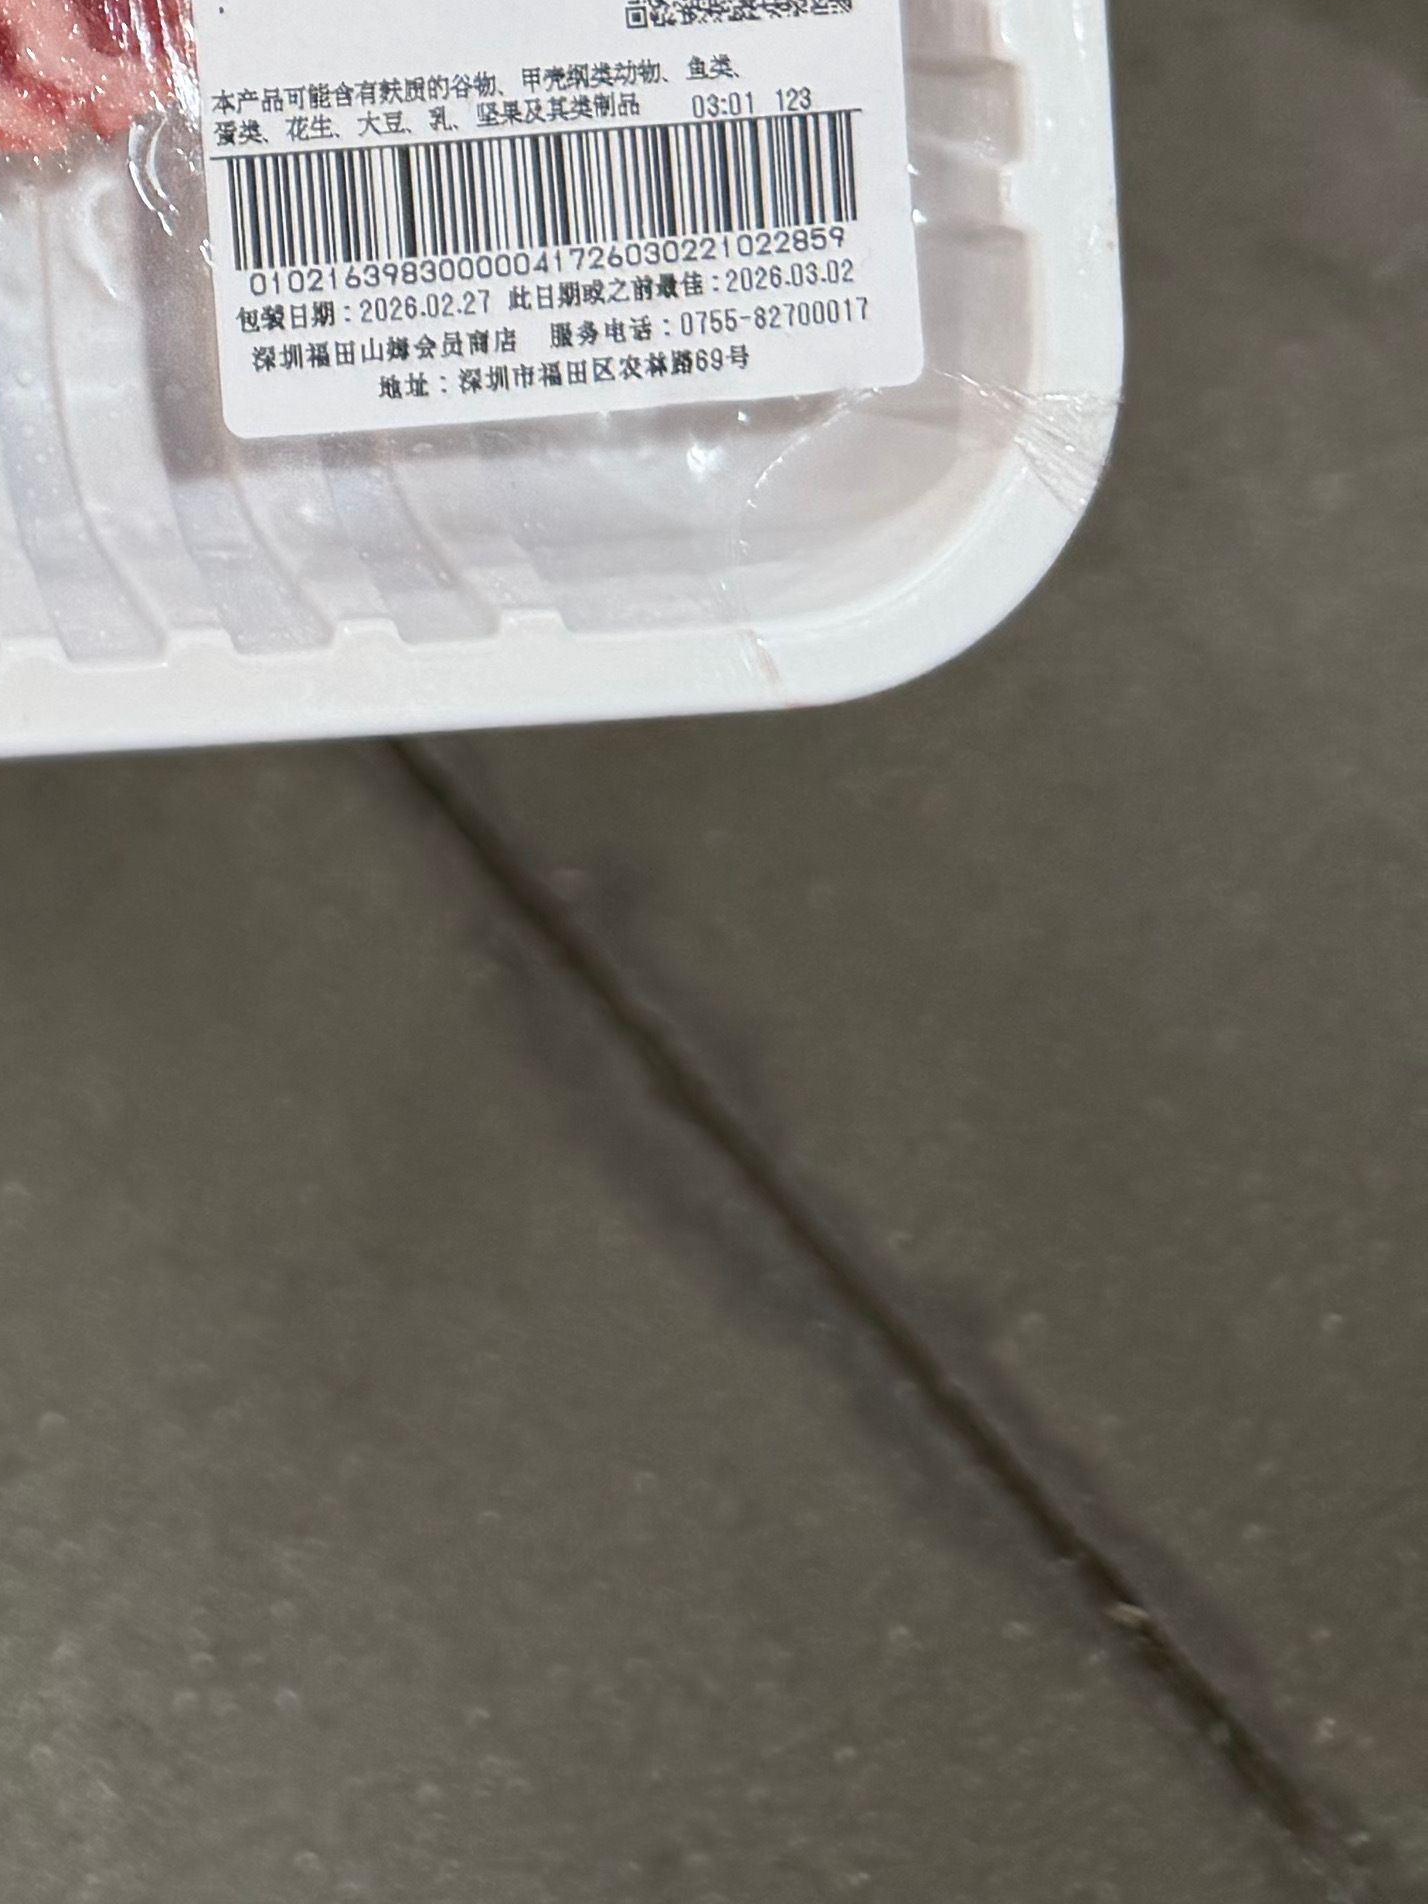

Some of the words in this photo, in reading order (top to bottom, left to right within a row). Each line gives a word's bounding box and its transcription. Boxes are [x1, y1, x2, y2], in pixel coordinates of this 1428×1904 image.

[691, 91, 755, 119] 03:01
[774, 85, 813, 112] 123
[251, 325, 518, 374] 深圳福田山姆会员商店
